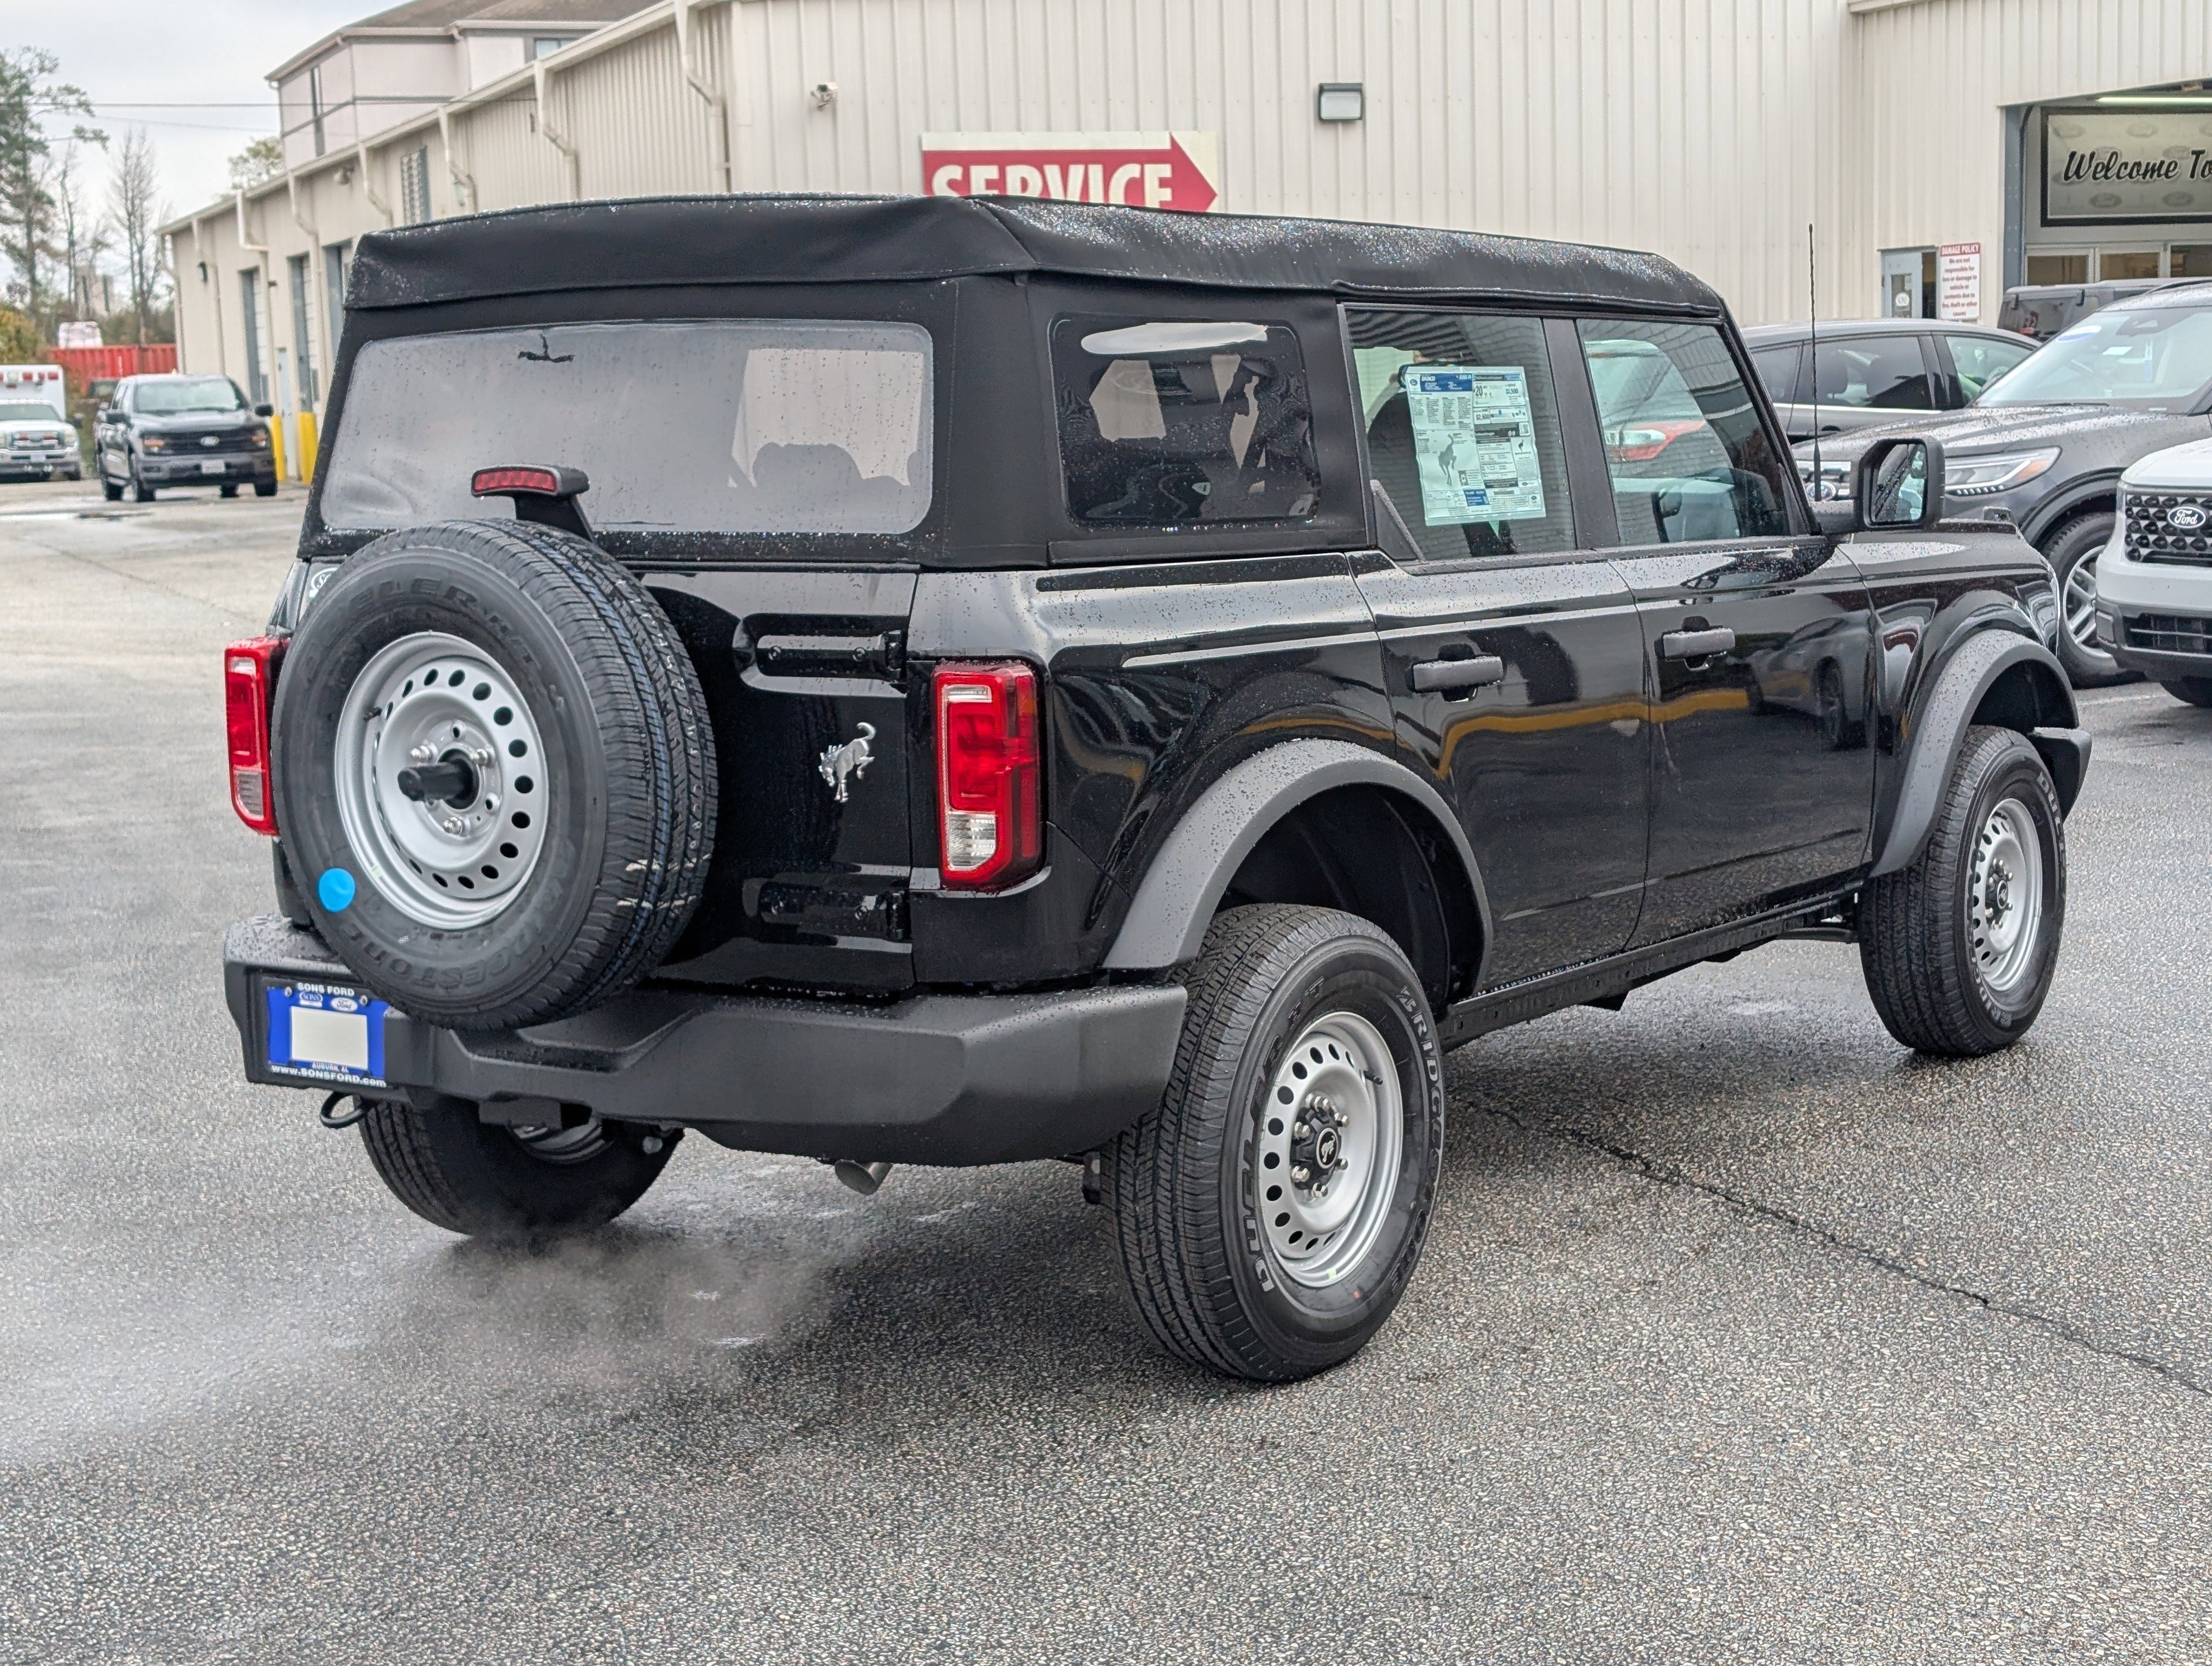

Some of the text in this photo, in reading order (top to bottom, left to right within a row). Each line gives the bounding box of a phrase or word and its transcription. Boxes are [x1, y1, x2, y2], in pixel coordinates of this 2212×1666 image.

[2063, 149, 2212, 181] Welcome To
[931, 163, 1173, 208] SERVICE
[1962, 244, 1979, 253] POLICY
[2174, 509, 2198, 525] Ford
[297, 982, 355, 997] SONS FORD
[271, 1065, 386, 1087] www.SONSFORD.com
